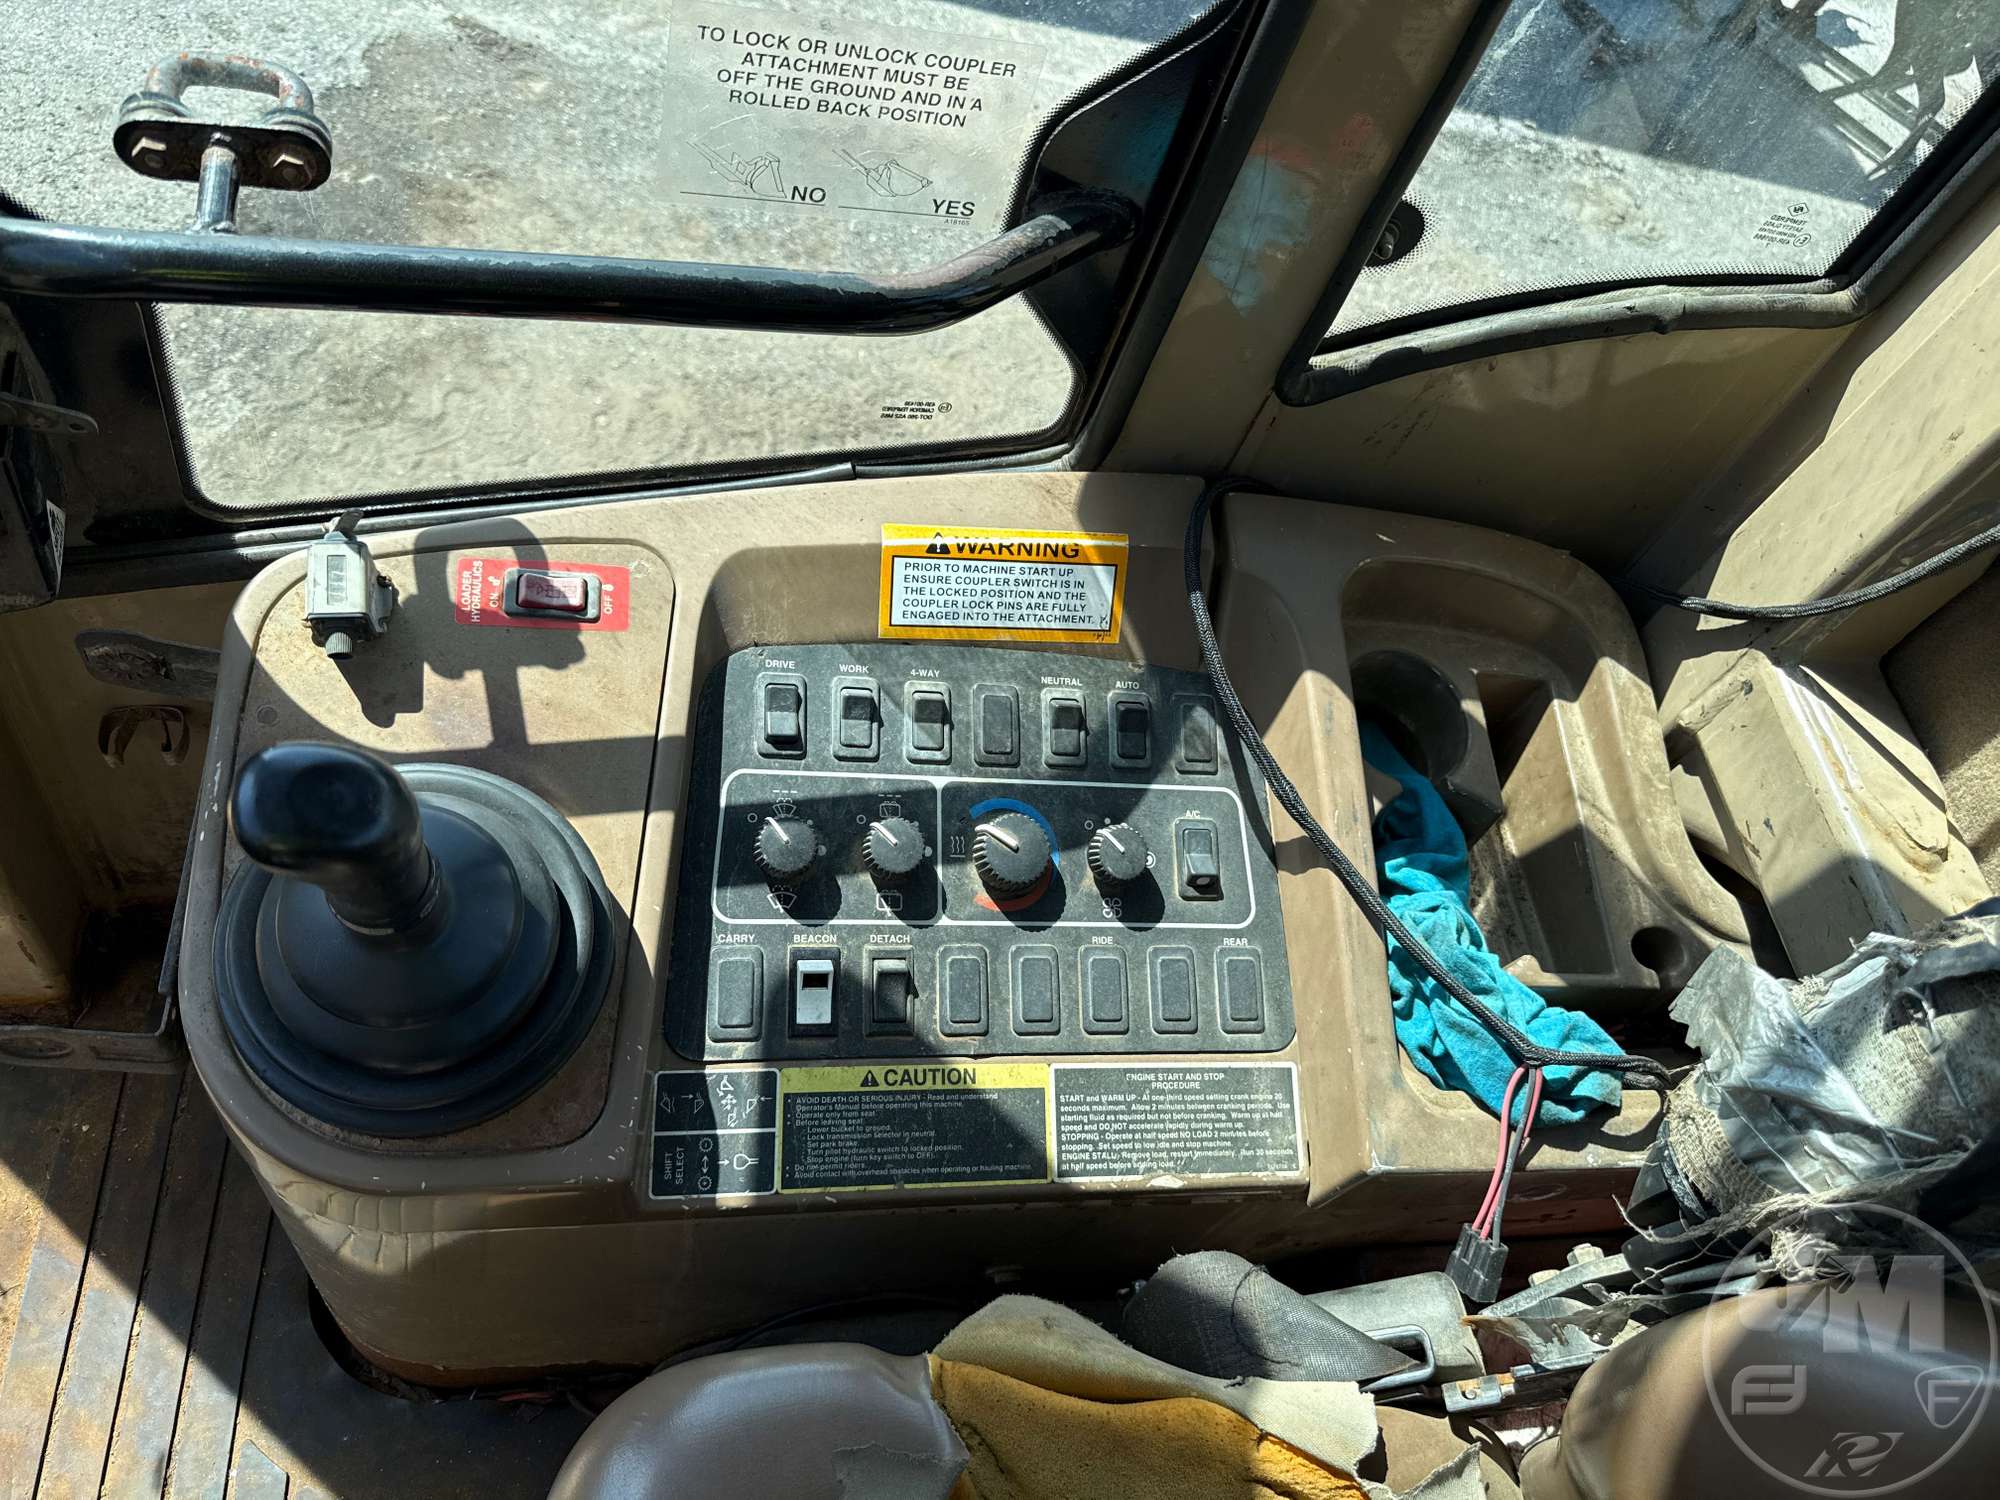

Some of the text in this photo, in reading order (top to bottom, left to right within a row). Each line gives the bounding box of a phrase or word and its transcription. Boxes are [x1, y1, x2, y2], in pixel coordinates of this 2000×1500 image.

[698, 25, 1016, 77] TO LOCK OR UNLOCK COUPLER
[741, 52, 970, 91] ATTACHMENT MUST BE
[717, 69, 983, 111] OFF THE GROUND AND IN A
[729, 89, 967, 127] ROLLED BACK POSITION
[790, 185, 827, 203] NO
[932, 198, 975, 217] YES
[954, 535, 1080, 558] WARNING
[904, 562, 1074, 577] PRIOR TO MACHINE START UP
[904, 574, 1085, 589] ENSURE COUPLER SWITCH IS IN
[461, 571, 472, 611] LOADER
[471, 559, 483, 622] HYDRAULICS
[904, 586, 1087, 601] THE LOCKED POSITION AND THE
[489, 593, 499, 608] ON
[604, 595, 614, 615] OFF
[903, 598, 1086, 612] COUPLER LOCK PINS ARE FULLY
[902, 610, 960, 621] ENGAGED
[963, 612, 989, 621] INTO
[993, 613, 1015, 622] THE
[765, 659, 796, 669] DRIVE
[839, 664, 869, 674] WORK
[910, 668, 940, 678] 4-WAY
[1041, 676, 1083, 687] NEUTRAL
[1115, 680, 1140, 690] AUTO
[1185, 809, 1201, 818] A/C
[718, 934, 755, 944] CARRY
[793, 934, 837, 944] BEACON
[870, 934, 911, 944] DETACH
[1092, 936, 1113, 945] RIDE
[1223, 937, 1248, 946] REAR
[883, 1068, 977, 1087] CAUTION
[1152, 1081, 1200, 1089] PROCEDURE
[895, 1094, 921, 1102] INJURY
[1101, 1094, 1124, 1102] WARM
[1184, 1093, 1204, 1101] speed
[1206, 1093, 1229, 1101] setting
[1251, 1093, 1273, 1101] engine
[885, 1102, 918, 1110] operating
[1061, 1104, 1090, 1112] seconds
[1216, 1103, 1245, 1111] cranking
[825, 1111, 841, 1119] only
[1061, 1114, 1088, 1122] starting
[1117, 1113, 1145, 1121] required
[1173, 1112, 1194, 1120] before
[821, 1118, 846, 1126] leaving
[1112, 1122, 1127, 1130] NOT
[1191, 1121, 1212, 1129] during
[1061, 1133, 1099, 1141] STOPPING
[1105, 1132, 1133, 1140] Operate
[1143, 1131, 1156, 1139] half
[1158, 1131, 1178, 1139] speed
[1193, 1130, 1213, 1138] LOAD
[1098, 1142, 1110, 1150] Set
[1112, 1142, 1133, 1150] speed
[1143, 1141, 1155, 1149] low
[1062, 1152, 1090, 1160] ENGINE
[1170, 1150, 1192, 1158] restart
[664, 1152, 673, 1180] SHIFT
[675, 1146, 685, 1185] SELECT
[1086, 1161, 1131, 1170] speed before
